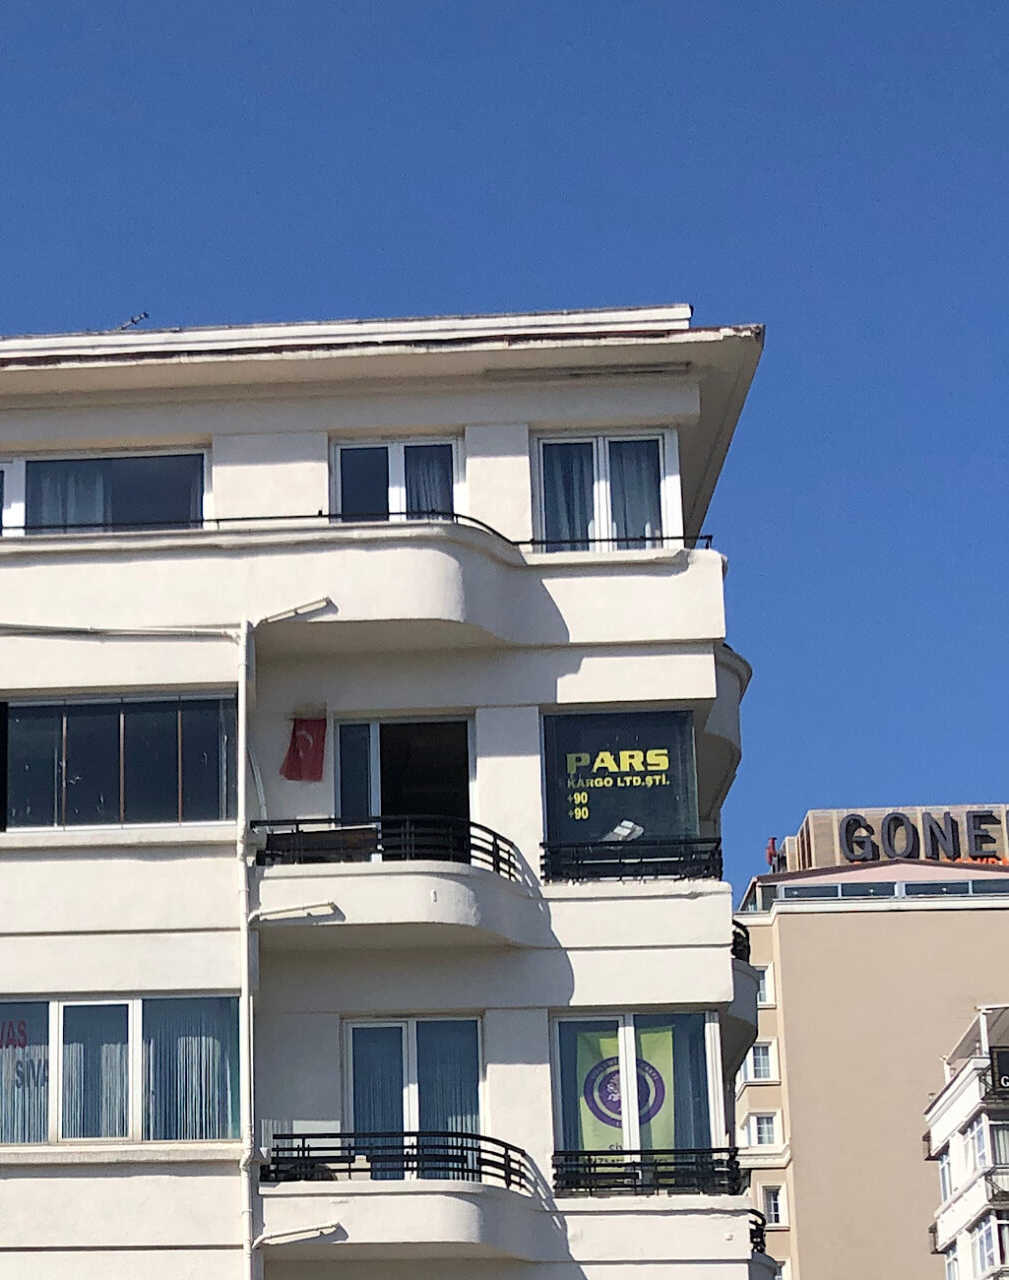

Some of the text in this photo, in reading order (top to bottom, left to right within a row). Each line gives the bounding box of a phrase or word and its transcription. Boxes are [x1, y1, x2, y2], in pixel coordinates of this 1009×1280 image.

[566, 749, 670, 774] PARS
[567, 777, 613, 789] KARGO
[567, 792, 588, 804] +90
[568, 807, 590, 819] +90
[840, 810, 1009, 863] GONE
